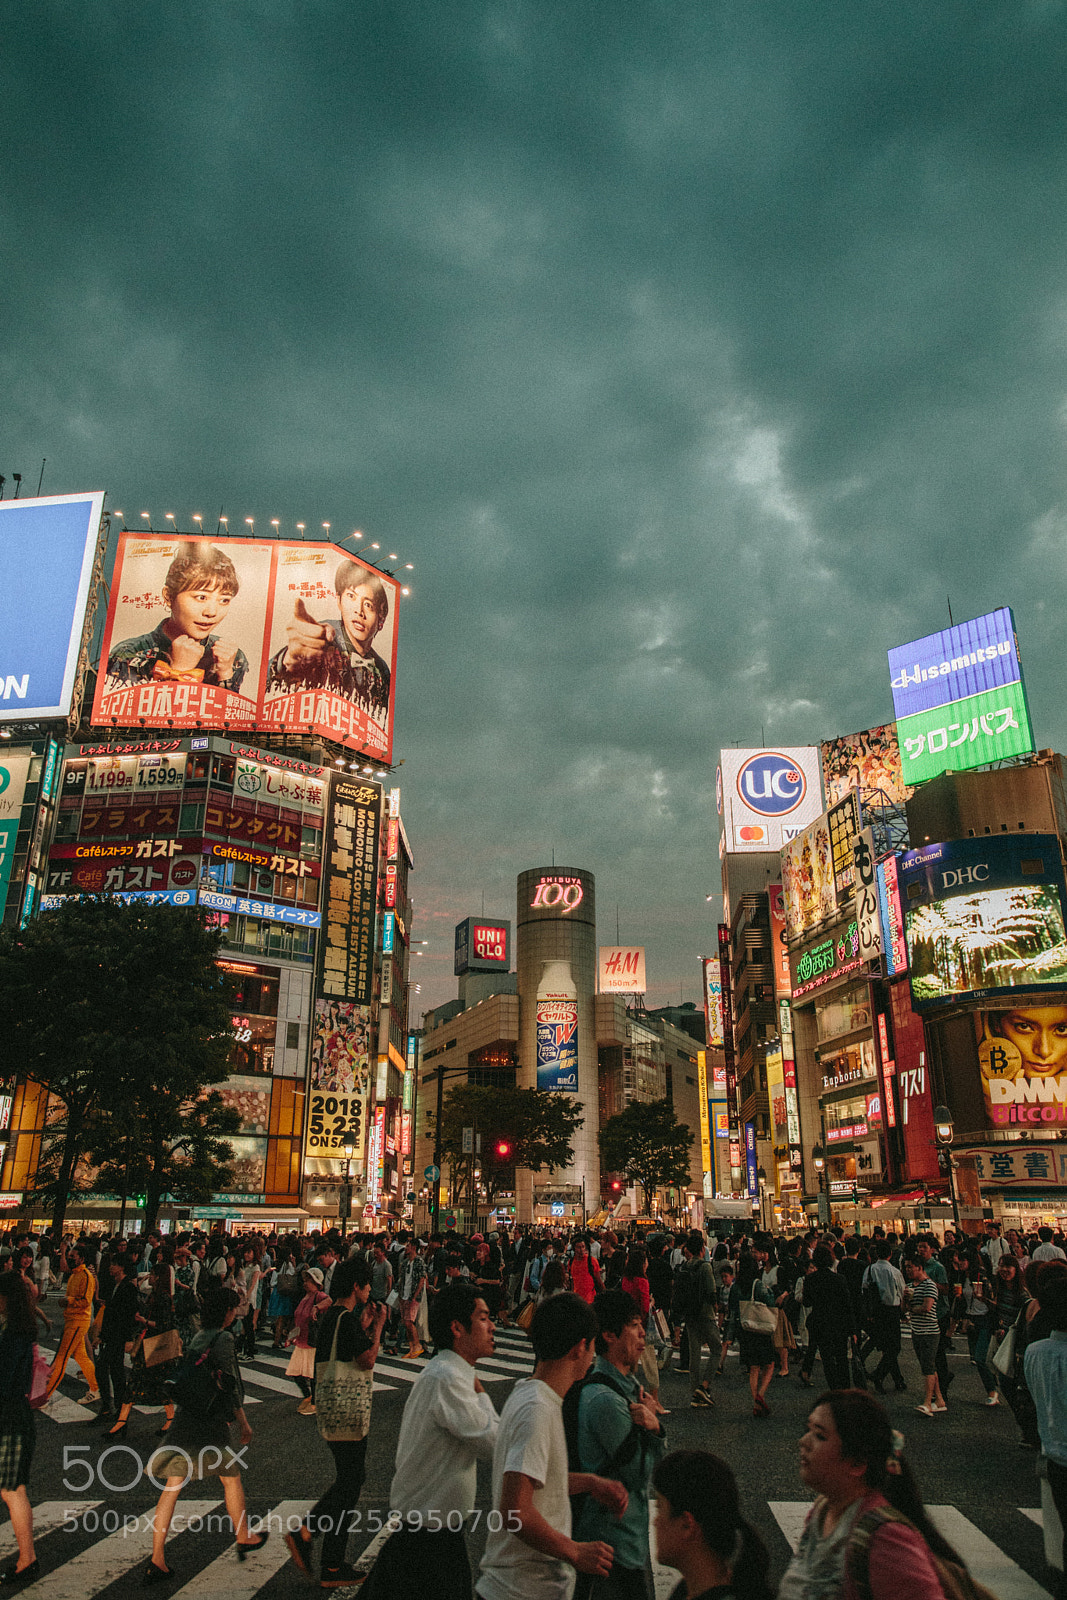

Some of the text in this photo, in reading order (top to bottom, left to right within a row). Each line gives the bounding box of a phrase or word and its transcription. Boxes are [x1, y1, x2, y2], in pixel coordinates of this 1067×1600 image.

[890, 640, 1011, 688] Hisamitsu
[0, 674, 30, 700] N
[100, 691, 129, 715] 5/27
[137, 685, 222, 719] 日本ダービー
[262, 697, 290, 721] 5/27
[225, 707, 256, 721] 芝2400m
[299, 693, 365, 740] 日本ダービー
[904, 707, 1019, 760] サロンパス
[80, 739, 182, 756] しゃぶしゃぶバイキング
[230, 742, 326, 777] しゃぶしゃぶバイキング
[66, 771, 85, 783] 9F
[266, 775, 323, 805] しゃぶ葉
[83, 808, 176, 831] プライス
[206, 809, 299, 844] コンタクト
[135, 840, 183, 859] ガスト
[901, 850, 943, 870] DHC Channel
[103, 866, 163, 890] ガスト
[270, 855, 313, 878] ガスト
[941, 863, 990, 889] DHC
[50, 871, 72, 887] 7F
[540, 876, 582, 885] SHIBUYA
[175, 894, 187, 902] 6F
[204, 894, 232, 907] AEON
[347, 808, 366, 998] MOMOIRO CLOVER Z BEST ALBUM
[387, 883, 395, 903] ガスト
[530, 883, 584, 913] 109
[853, 835, 882, 953] もんじゃ
[238, 900, 319, 924] 英会話イーオン
[883, 862, 901, 967] 三千里薬品
[477, 930, 500, 943] UNI
[477, 943, 503, 957] QLO
[813, 947, 834, 976] 西村
[605, 951, 640, 975] H&M
[608, 979, 630, 987] 150m
[974, 990, 988, 998] DHC
[537, 1002, 577, 1012] シンバイオティクス
[544, 1013, 571, 1021] ヤクルト
[555, 1020, 578, 1046] W
[823, 1066, 861, 1088] Euphoria
[312, 1096, 362, 1117] 2018
[993, 1103, 1067, 1123] Bitcoi
[309, 1115, 361, 1137] 5.23
[309, 1136, 361, 1149] ON SAE
